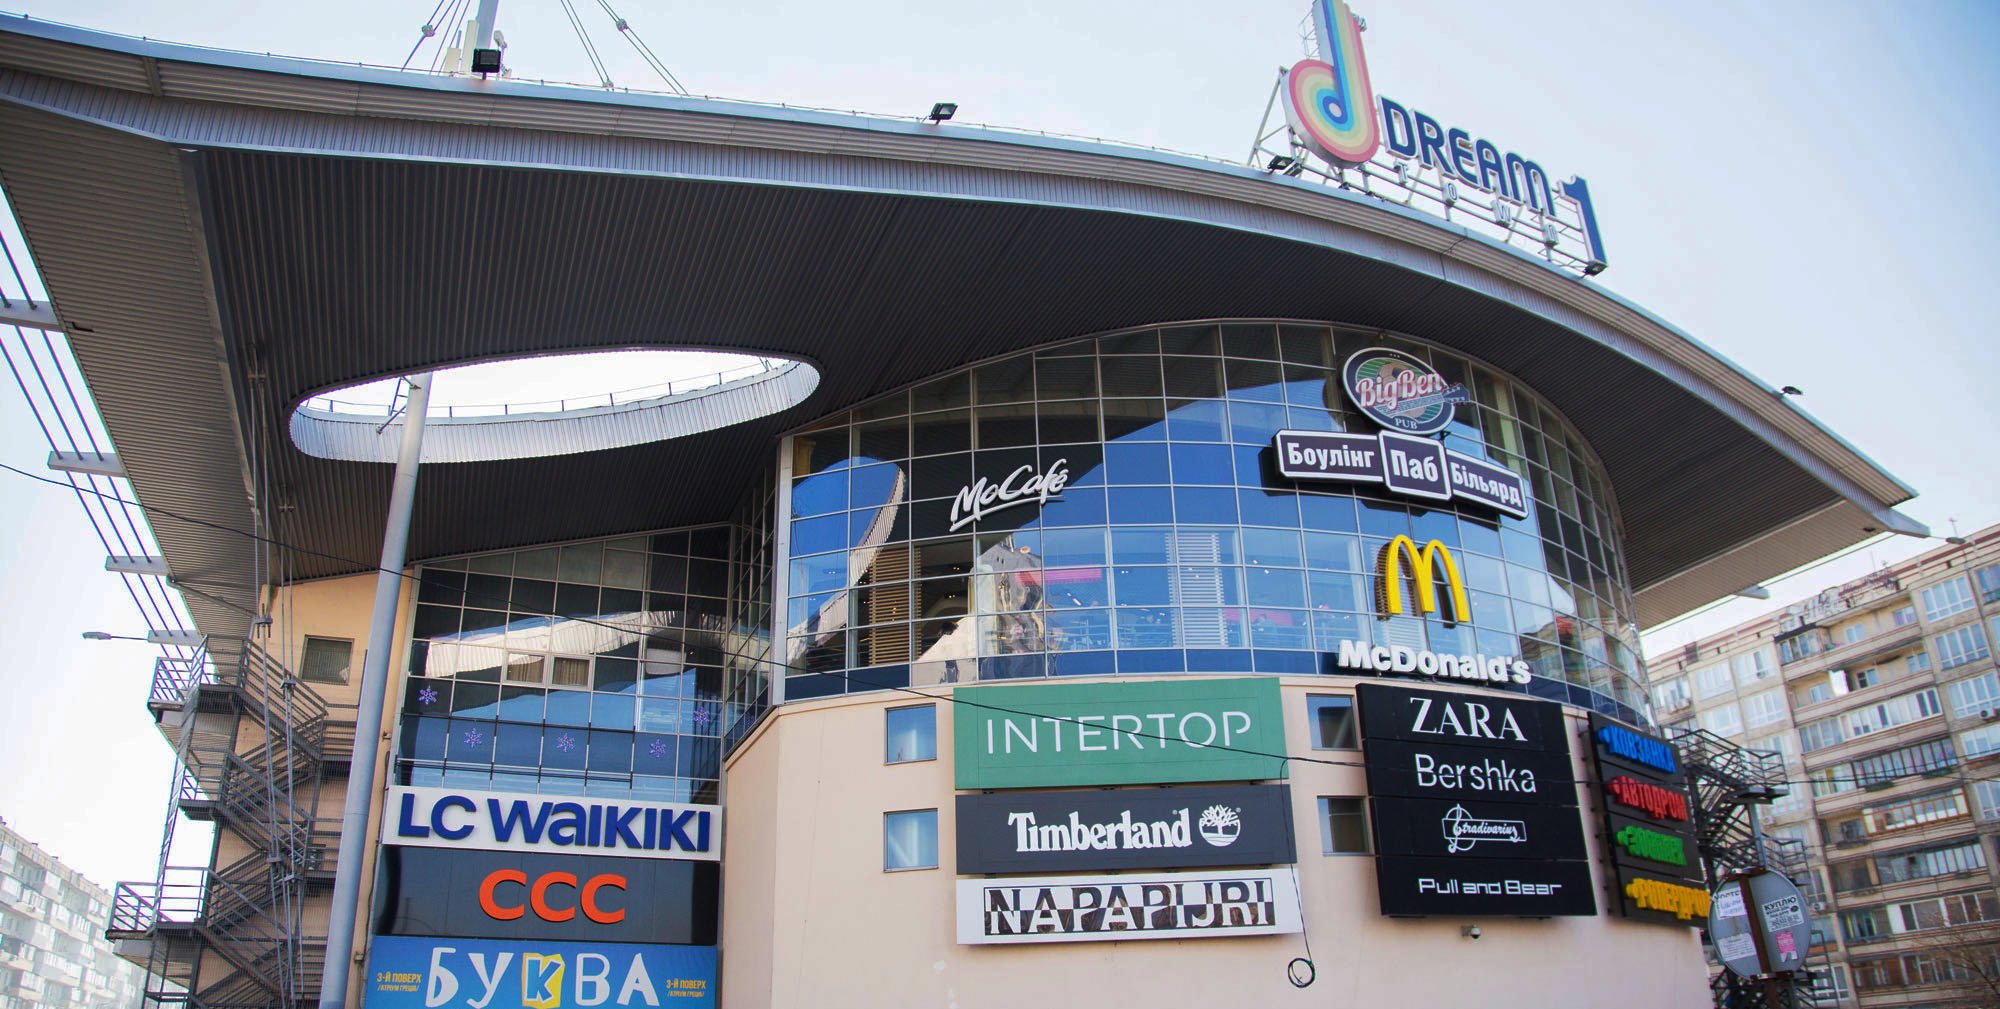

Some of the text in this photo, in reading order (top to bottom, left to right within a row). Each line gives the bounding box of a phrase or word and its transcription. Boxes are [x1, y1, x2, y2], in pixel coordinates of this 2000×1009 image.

[1377, 94, 1557, 218] DREAM
[1394, 418, 1418, 430] PUB
[1287, 442, 1375, 469] Боулінг
[1391, 449, 1439, 482] Паб
[950, 458, 1069, 524] McCafé
[1450, 462, 1523, 507] Більярд
[1338, 640, 1532, 684] McDonald's
[987, 710, 1251, 754] INTERTOP
[1410, 697, 1528, 742] ZARA
[1415, 753, 1537, 793] Bershka
[398, 793, 477, 840] LC
[1619, 777, 1688, 821] АВТОДРОМ
[1008, 808, 1192, 852] Timberland
[478, 869, 627, 924] CCC
[987, 881, 1272, 934] NAPAPIJRI
[1418, 878, 1562, 895] Pull and Bear
[424, 946, 661, 1009] БУКВА
